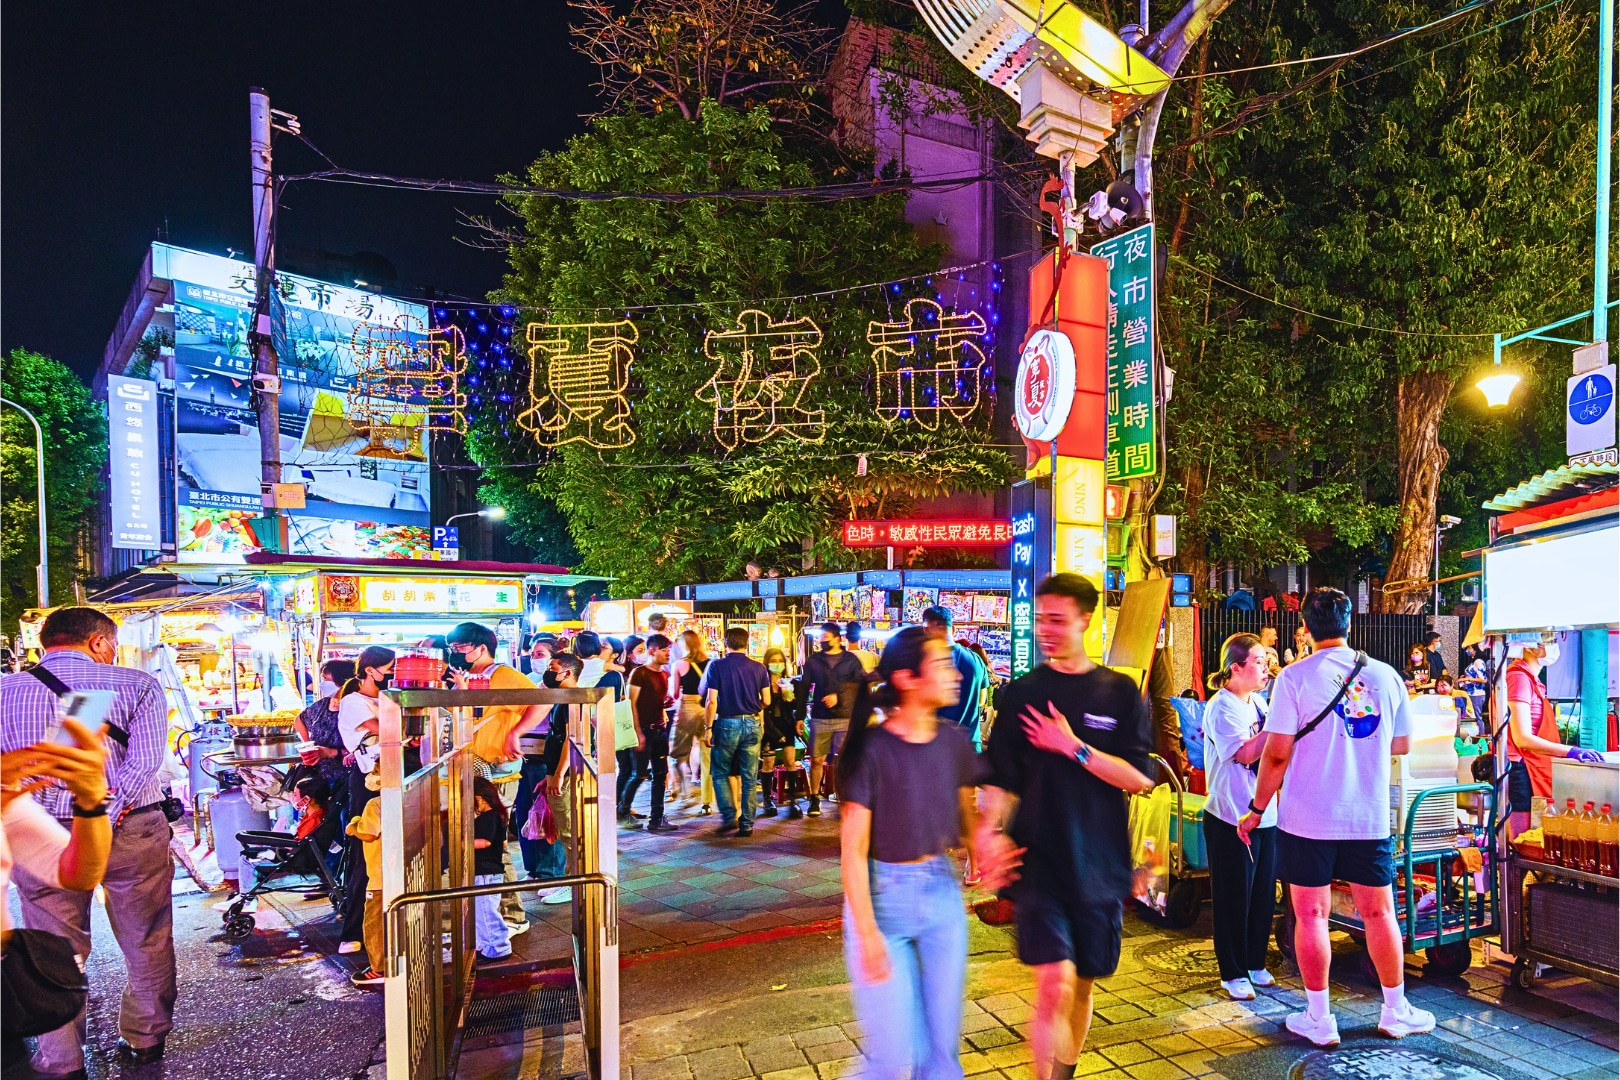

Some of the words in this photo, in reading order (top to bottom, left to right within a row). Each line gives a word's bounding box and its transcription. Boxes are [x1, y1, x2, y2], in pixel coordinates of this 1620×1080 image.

[1122, 233, 1151, 474] 夜市營業時間
[348, 297, 987, 455] 寧夏夜市
[1027, 357, 1043, 408] 寧夏
[1074, 482, 1086, 515] NING
[434, 527, 447, 541] P
[1012, 513, 1035, 538] icash
[1014, 542, 1032, 566] Pay
[1074, 536, 1085, 559] XIA
[1014, 602, 1031, 680] 寧夏
